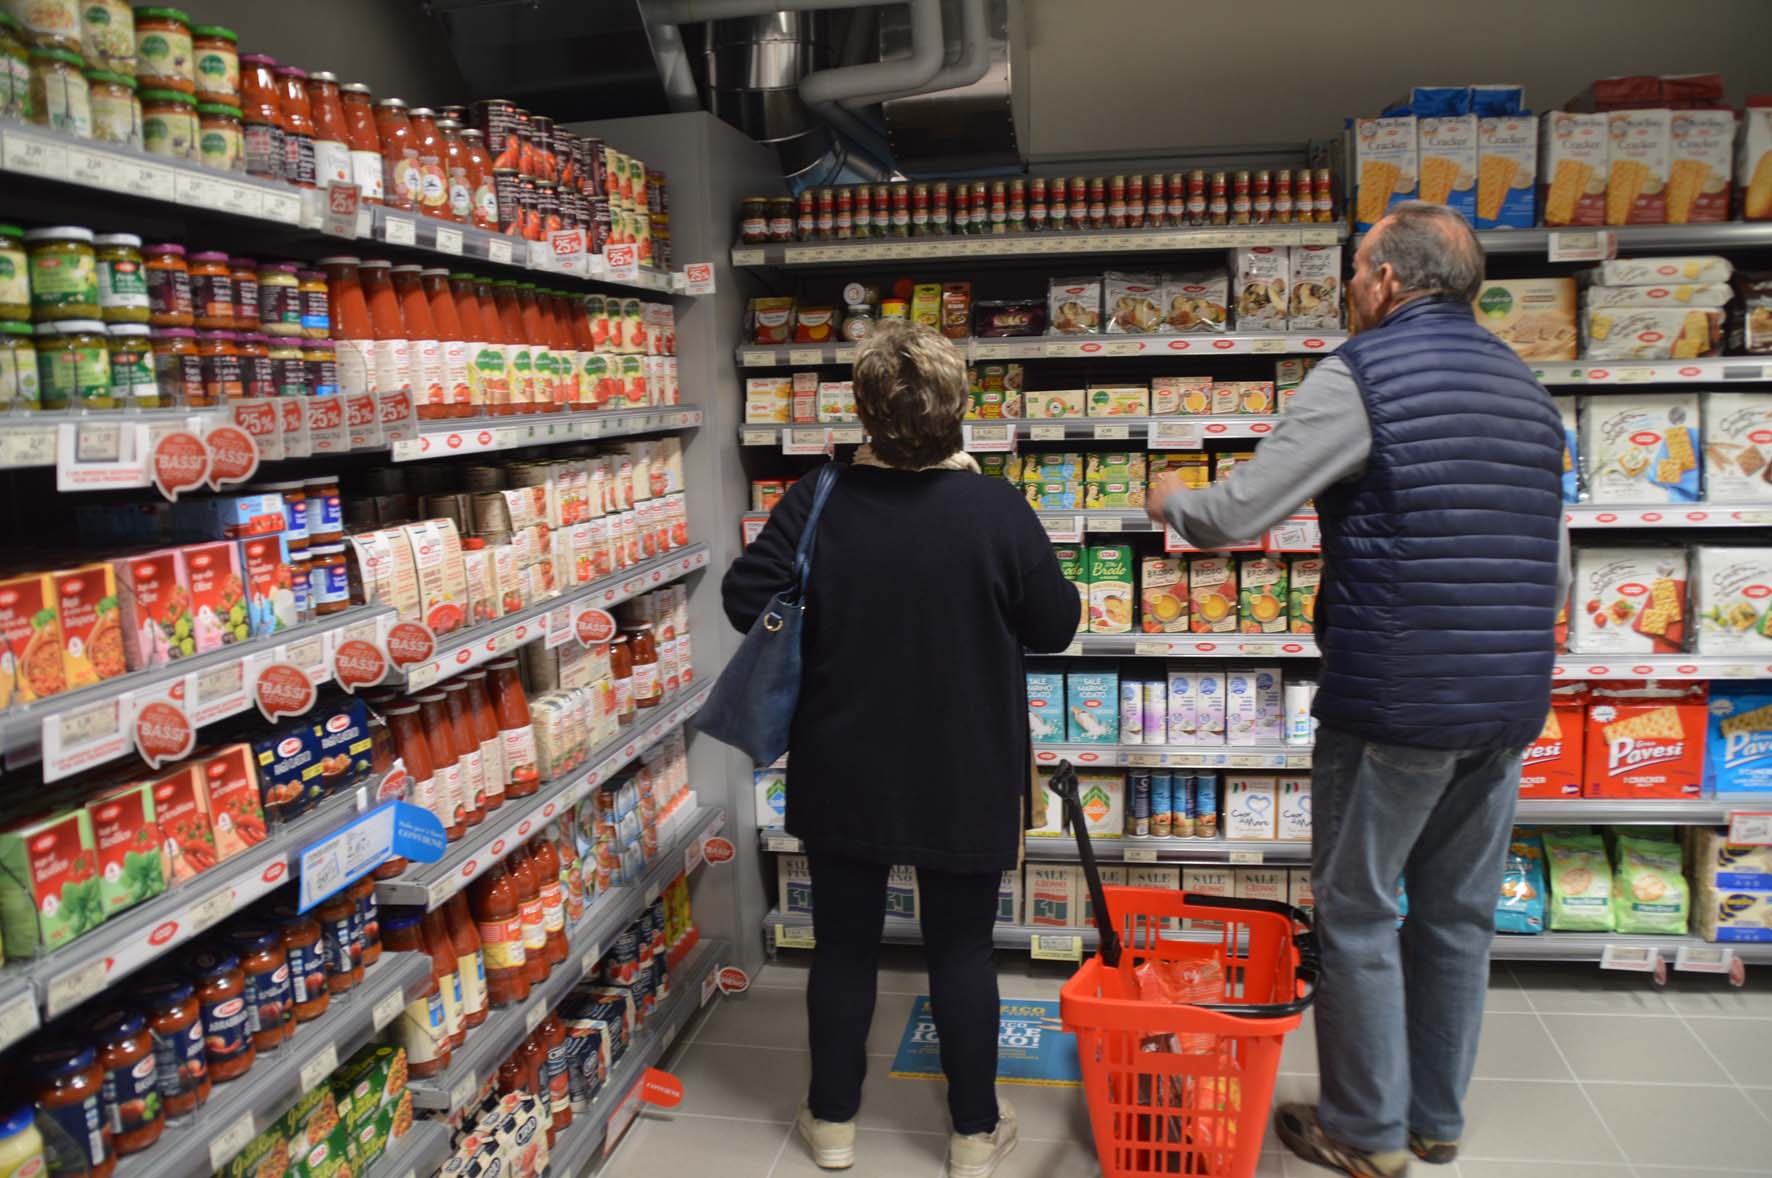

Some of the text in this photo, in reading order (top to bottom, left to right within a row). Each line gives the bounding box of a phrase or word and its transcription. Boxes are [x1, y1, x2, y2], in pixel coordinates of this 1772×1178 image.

[556, 239, 580, 255] 25%
[610, 252, 632, 267] 25%
[309, 408, 340, 431] 25%
[158, 453, 202, 469] BASSI
[1092, 562, 1126, 577] Brodo
[390, 637, 433, 652] BASSI
[339, 656, 379, 672] BASSI
[262, 682, 306, 700] BASSI
[141, 723, 185, 741] BASSI
[1522, 742, 1562, 761] vesi
[1609, 736, 1683, 769] Pavesi
[1725, 731, 1772, 763] Pav
[1036, 870, 1067, 880] SALE
[1138, 873, 1170, 883] SALE
[1193, 874, 1225, 885] SALE
[1246, 873, 1278, 885] SALE
